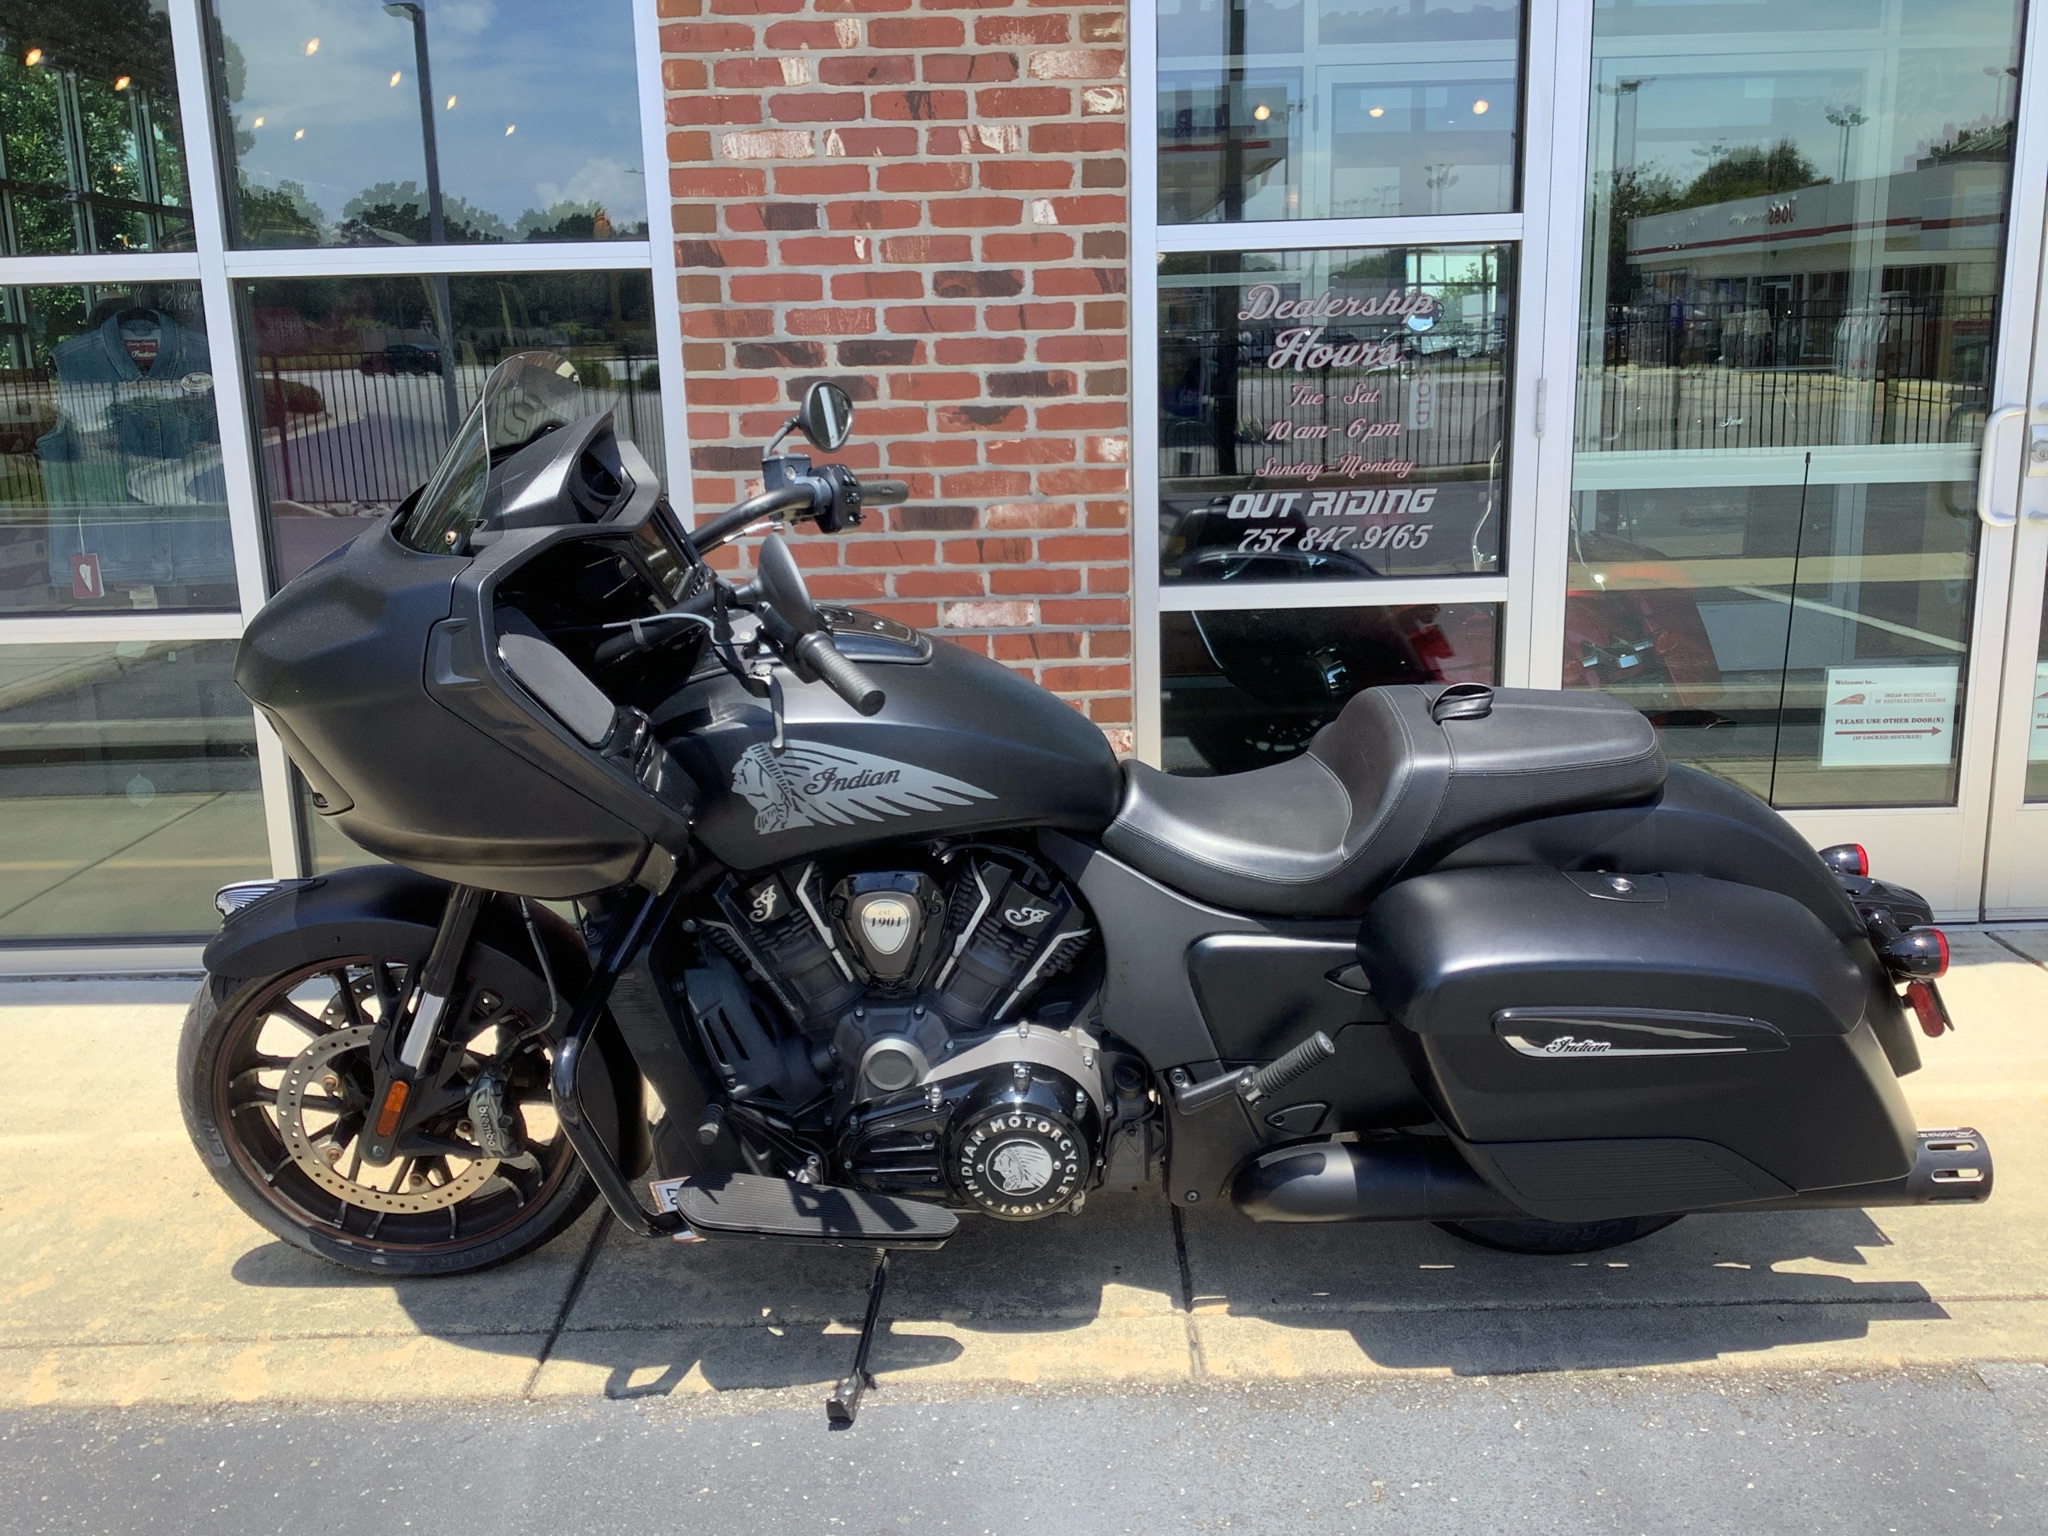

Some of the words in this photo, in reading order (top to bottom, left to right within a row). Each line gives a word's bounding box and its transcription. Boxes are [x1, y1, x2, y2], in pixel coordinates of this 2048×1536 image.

[1237, 282, 1434, 324] Dealership
[1267, 325, 1403, 371] Hours
[1290, 384, 1325, 407] Tue
[1344, 383, 1380, 405] Sat
[1266, 420, 1292, 440] 10
[1294, 425, 1327, 440] am
[1347, 418, 1366, 438] 6
[1361, 422, 1401, 443] pm
[1255, 457, 1324, 481] Sunday
[1337, 454, 1415, 479] Monday
[1227, 492, 1303, 519] OUT
[1307, 488, 1438, 517] RIDING
[1238, 528, 1297, 553] 757
[1298, 524, 1434, 551] 847.9165
[803, 767, 901, 795] Indian
[871, 916, 902, 928] 1901
[1545, 1036, 1611, 1053] Indian
[478, 1105, 496, 1147] brembo
[961, 1130, 986, 1198] INDIAN
[989, 1116, 1077, 1195] MOTORCYCLE
[1000, 1203, 1043, 1214] 1901
